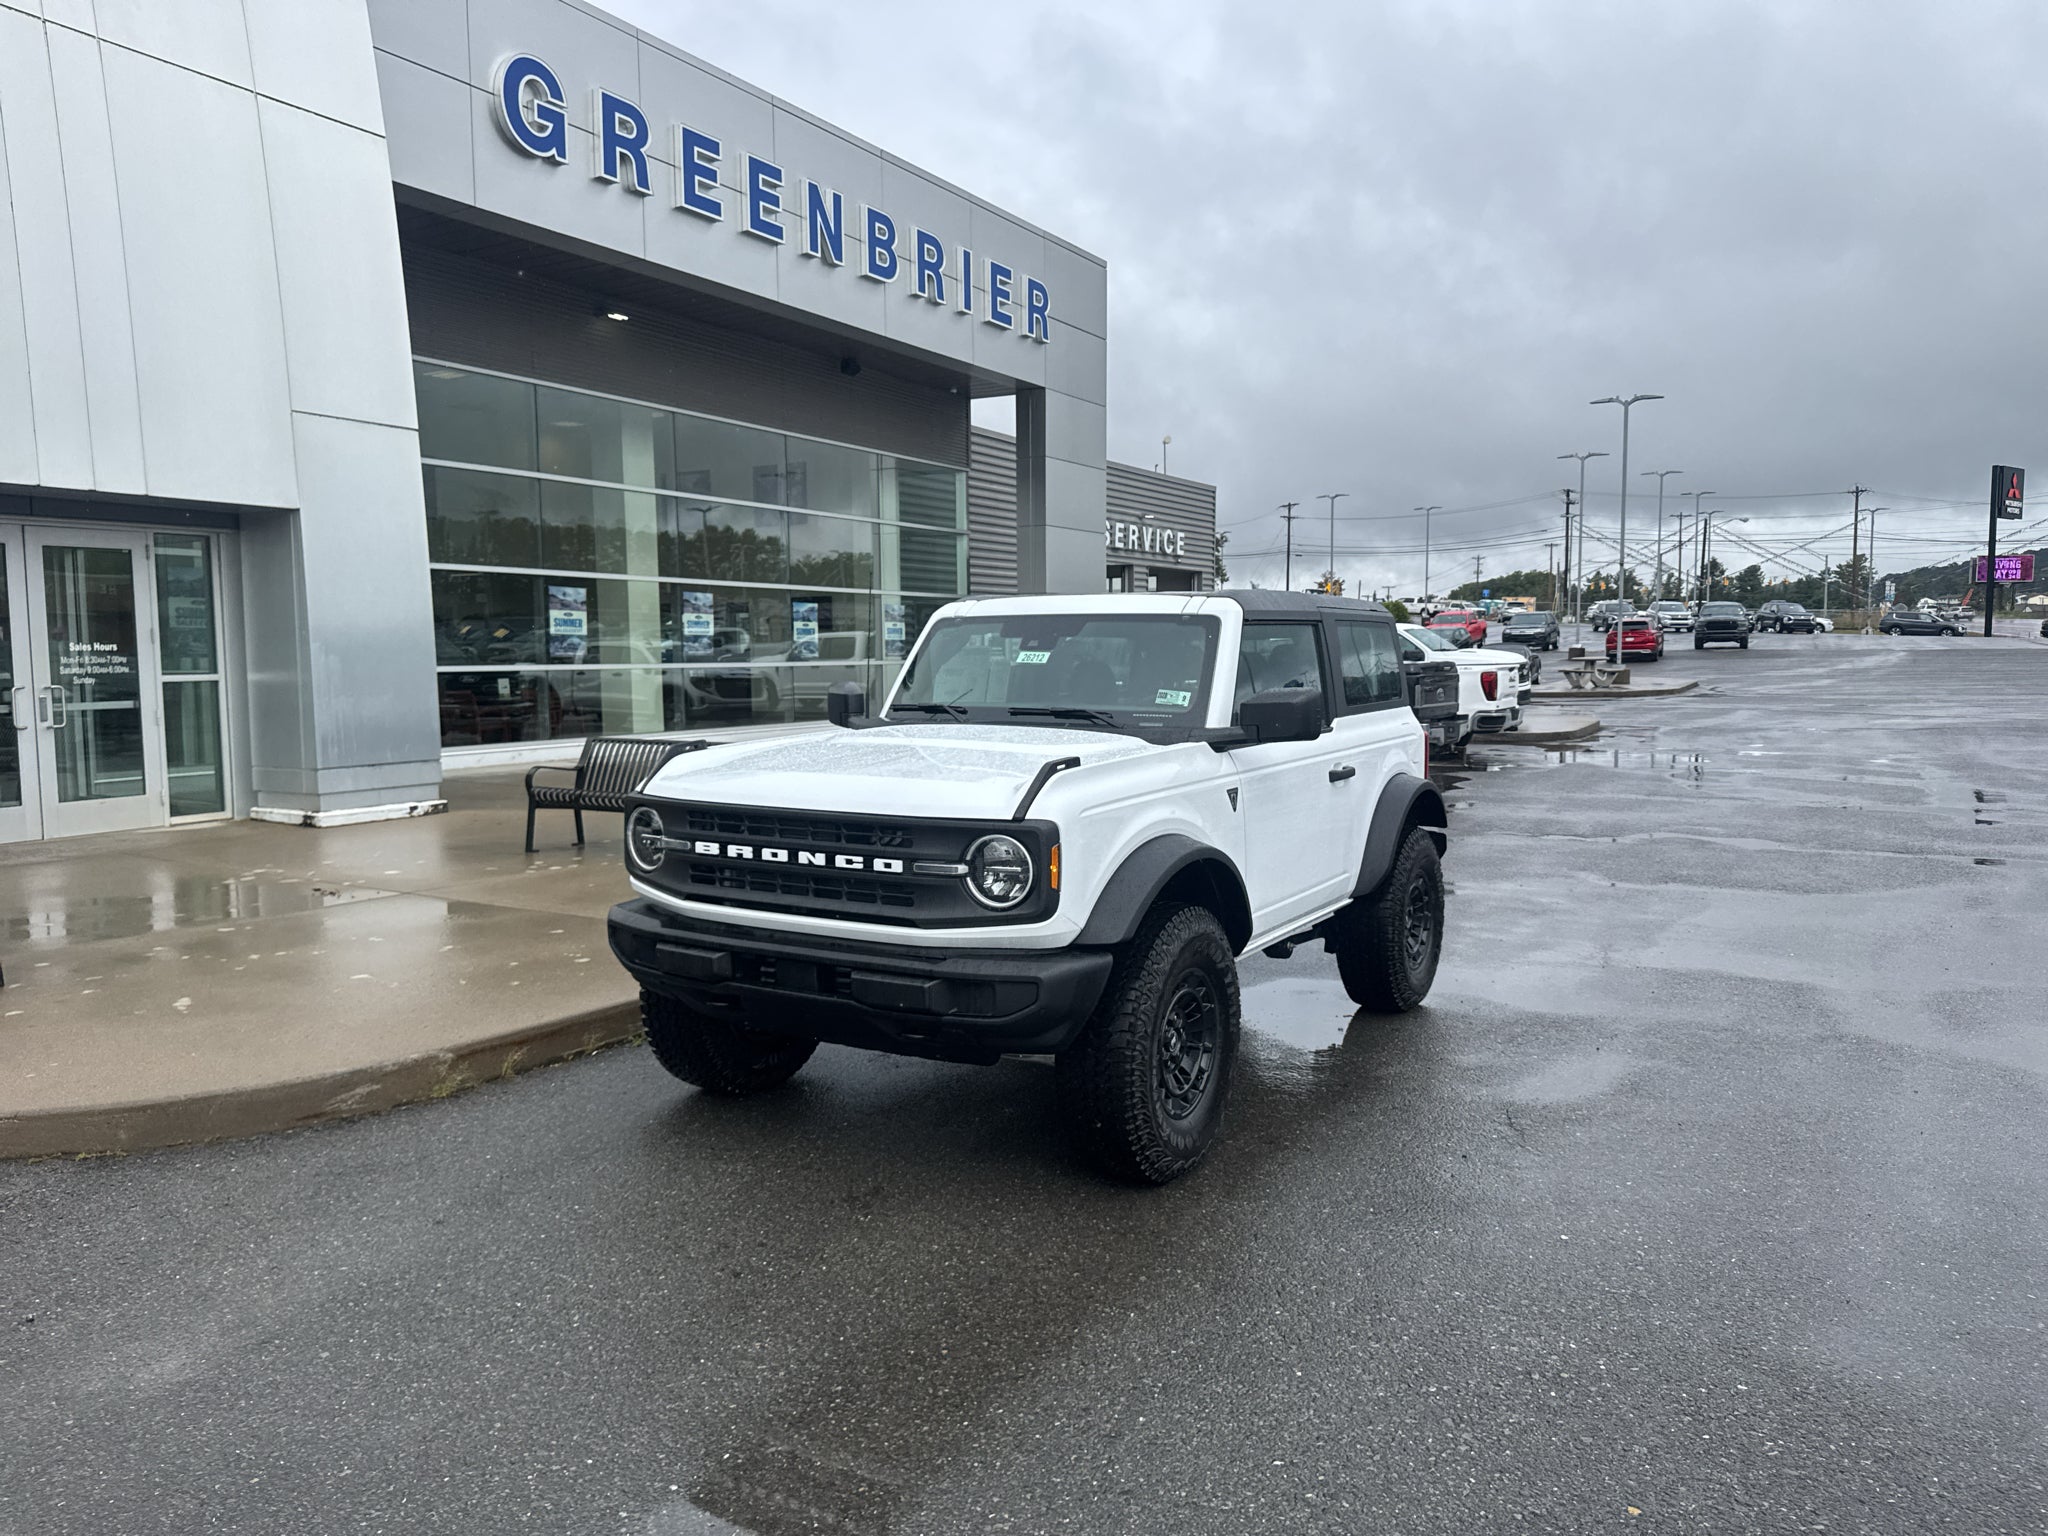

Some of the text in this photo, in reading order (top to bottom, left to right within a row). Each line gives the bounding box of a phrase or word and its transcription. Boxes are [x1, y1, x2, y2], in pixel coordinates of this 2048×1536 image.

[495, 52, 1050, 344] GREENBRIER
[69, 642, 118, 652] Sales Hours
[60, 666, 86, 676] Saturday
[73, 676, 96, 686] Sunday
[695, 841, 903, 873] BRONCO
